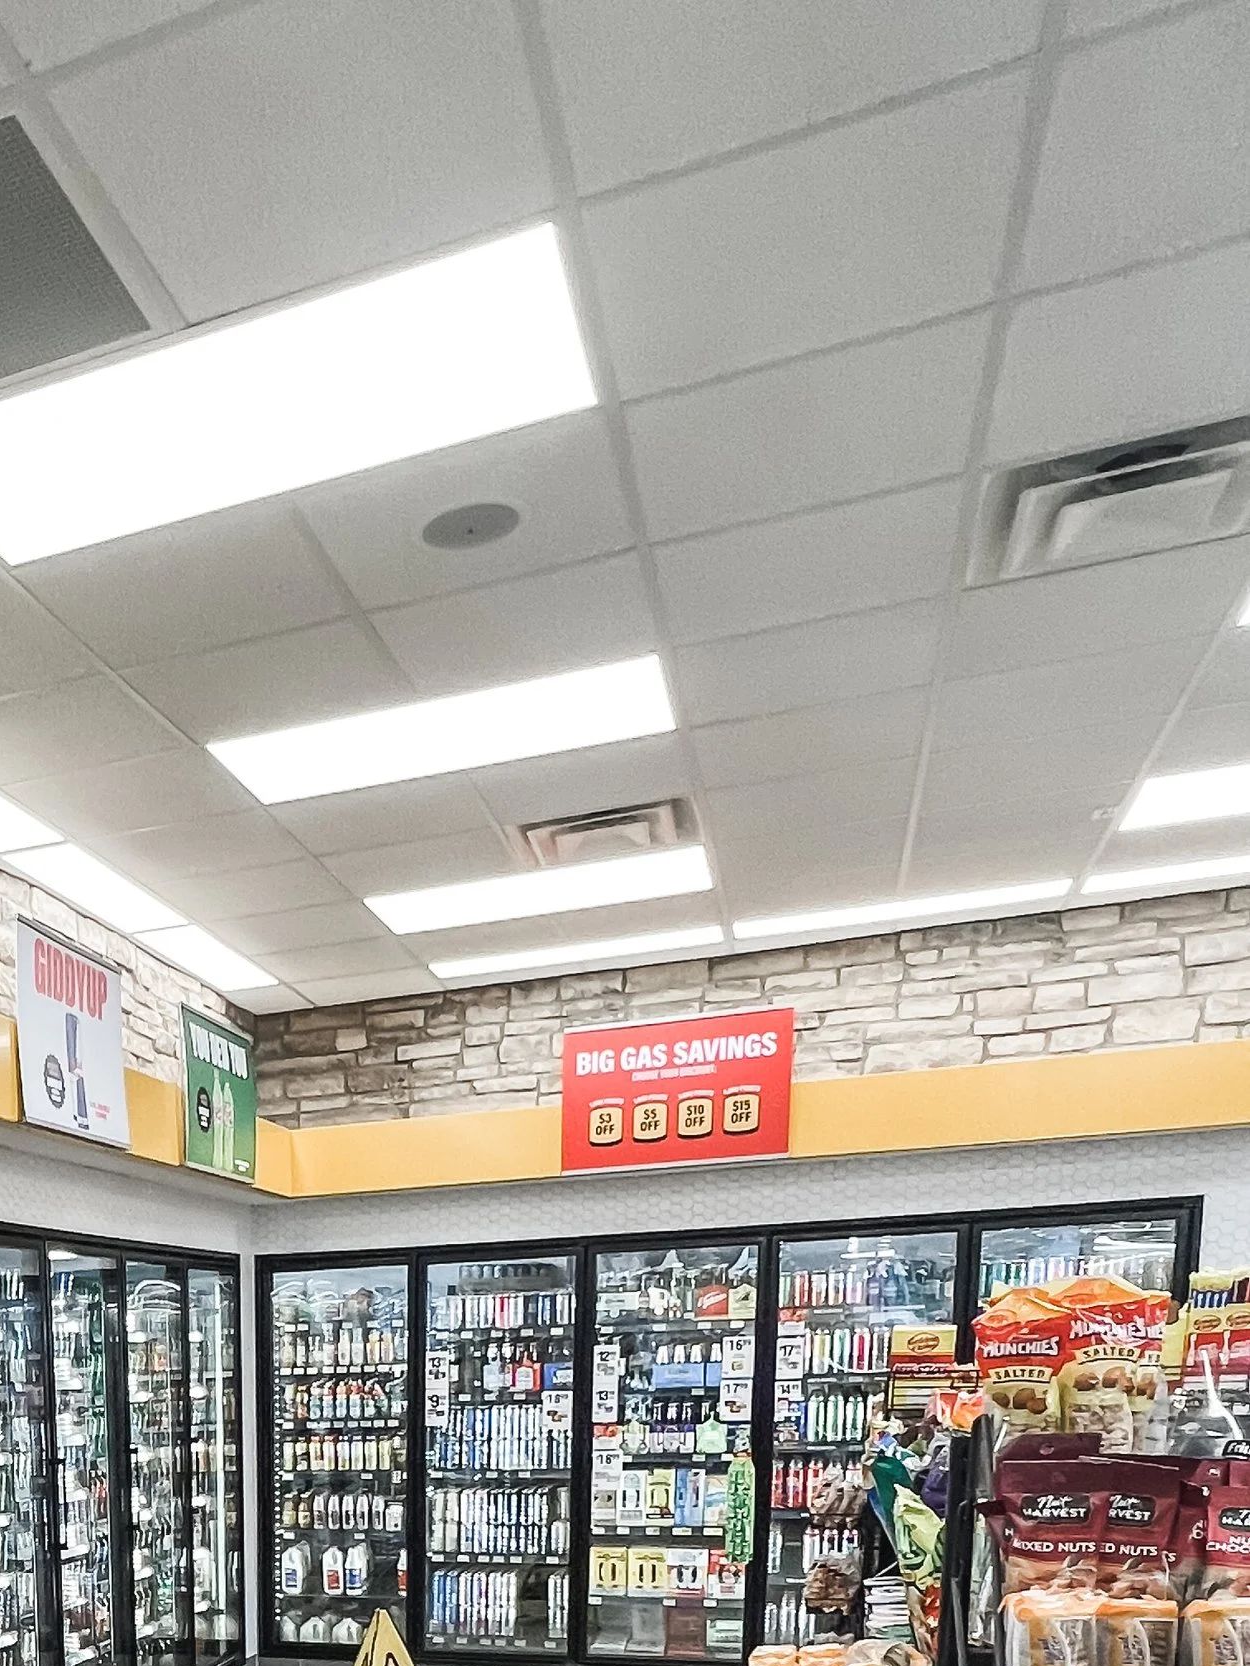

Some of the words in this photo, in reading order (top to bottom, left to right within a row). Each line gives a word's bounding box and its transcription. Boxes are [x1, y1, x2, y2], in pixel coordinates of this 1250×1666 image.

[34, 938, 108, 1020] GIDDYUP
[575, 1049, 615, 1076] BIG
[620, 1043, 668, 1071] GAS
[673, 1032, 778, 1066] SAVINGS
[686, 1105, 705, 1116] $10
[732, 1100, 751, 1112] $15
[599, 1113, 612, 1124] $3
[684, 1116, 705, 1128] OFF
[731, 1112, 751, 1124] OFF
[595, 1124, 615, 1136] OFF
[640, 1120, 660, 1132] OFF
[983, 1336, 1060, 1358] MUNCHIES
[1082, 1347, 1135, 1359] SALTED
[994, 1369, 1045, 1380] SALTED
[1022, 1506, 1087, 1518] HARVEST
[1057, 1542, 1096, 1553] NUTS
[1119, 1545, 1158, 1557] NUTS
